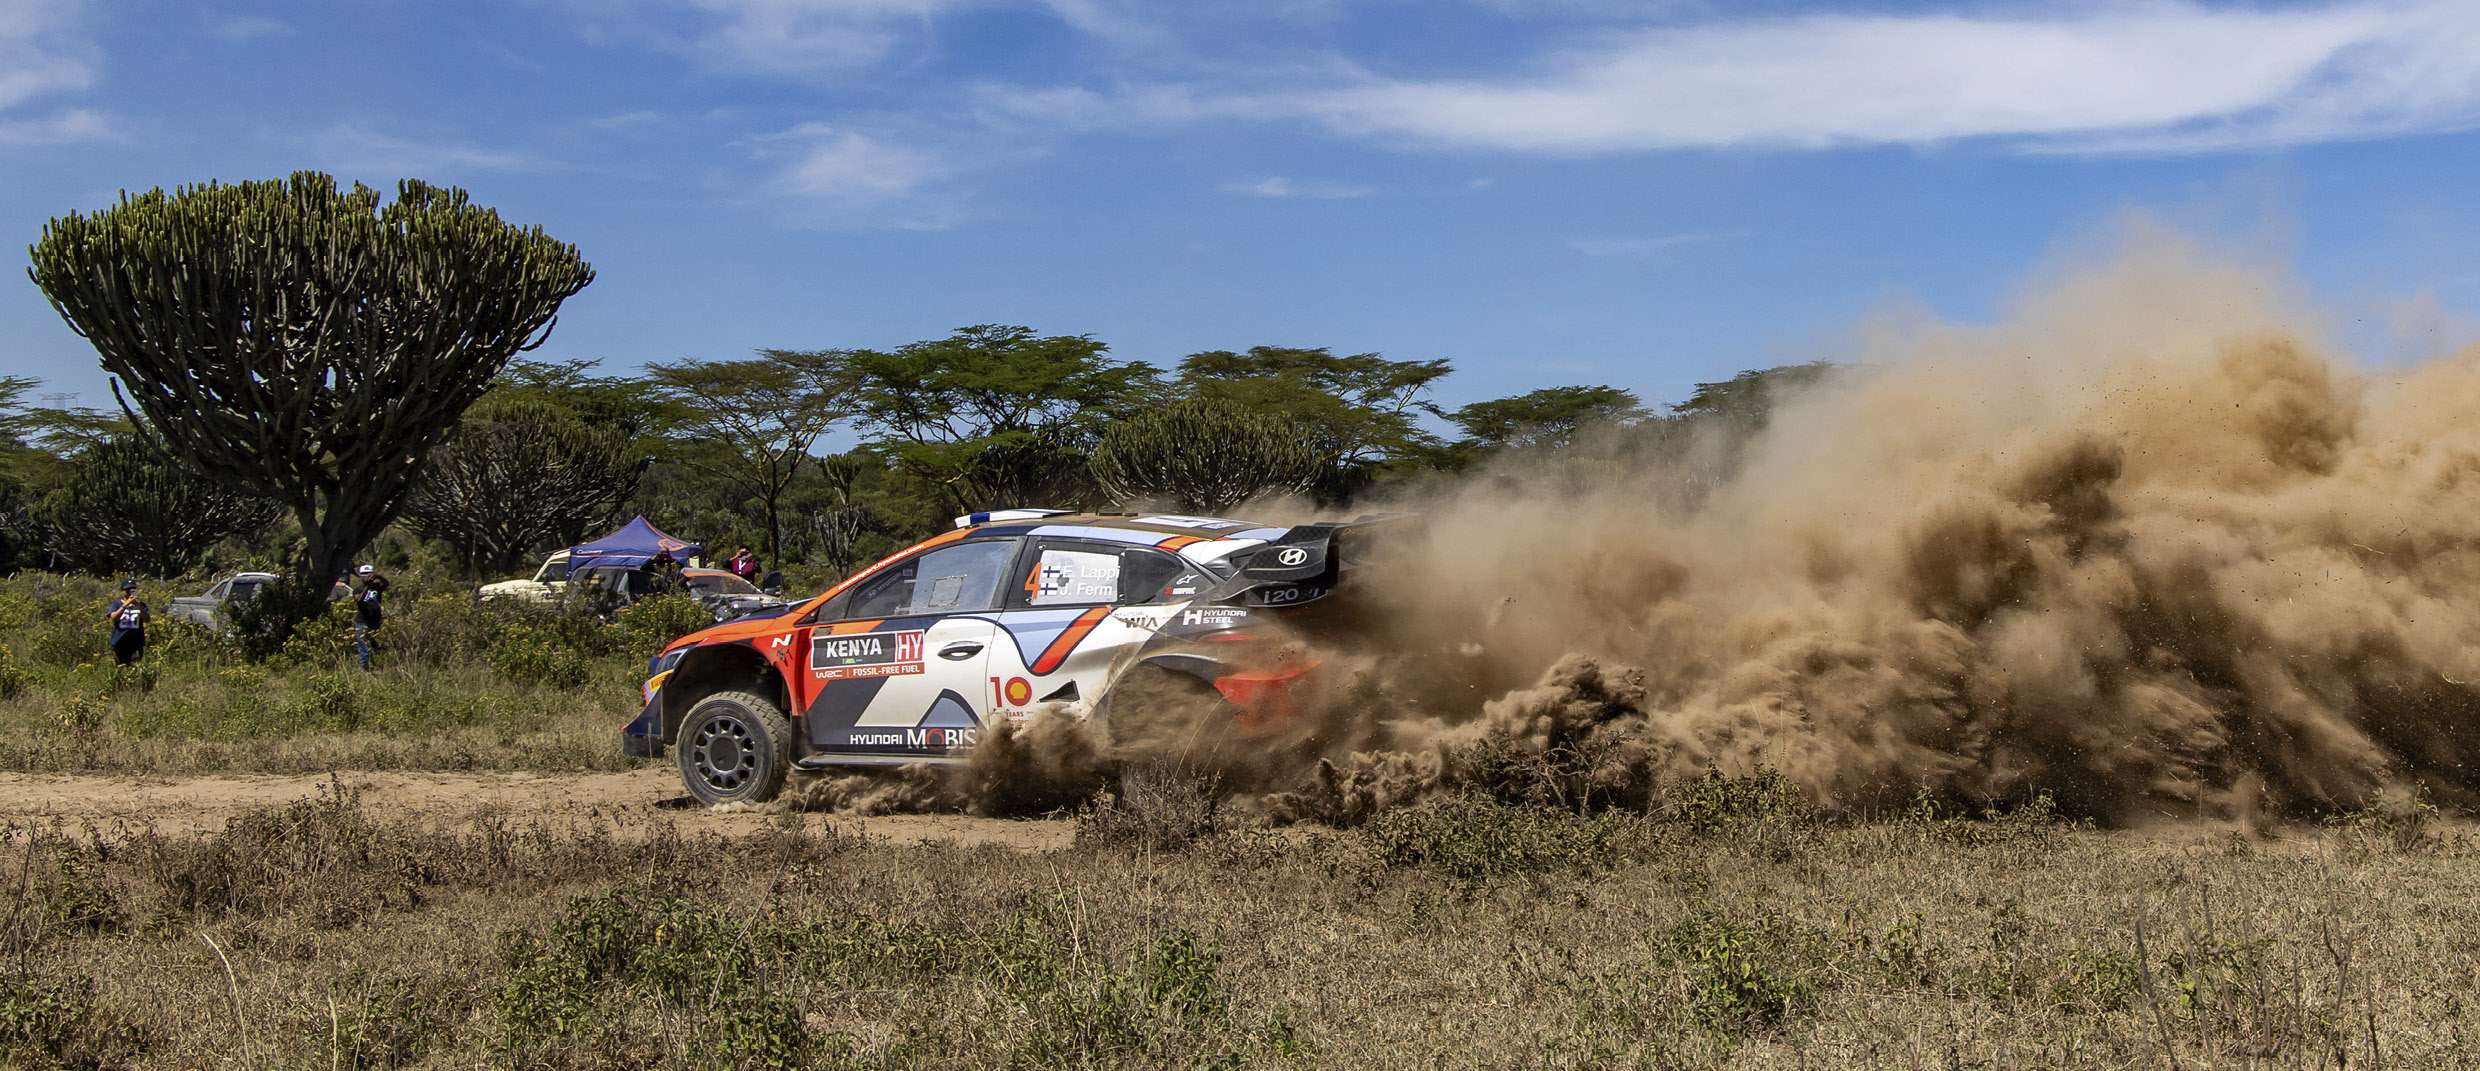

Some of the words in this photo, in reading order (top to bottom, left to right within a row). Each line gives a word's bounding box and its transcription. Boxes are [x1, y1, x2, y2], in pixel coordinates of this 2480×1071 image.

[838, 544, 924, 590] motorsport.hyundai.com
[1062, 565, 1077, 578] E.
[1081, 565, 1121, 581] Lappi
[1024, 562, 1042, 599] 4
[1060, 583, 1077, 596] J.
[1081, 583, 1113, 596] Ferm
[1202, 616, 1234, 624] STEEL
[1203, 609, 1247, 617] HYUNDAI
[826, 638, 882, 658] KENYA
[898, 634, 922, 660] HY
[816, 670, 843, 679] WRC
[853, 666, 900, 676] FOSSIL-FREE
[901, 665, 920, 673] FUEL
[849, 734, 902, 745] HYUNDAI
[907, 728, 977, 750] MOBIS
